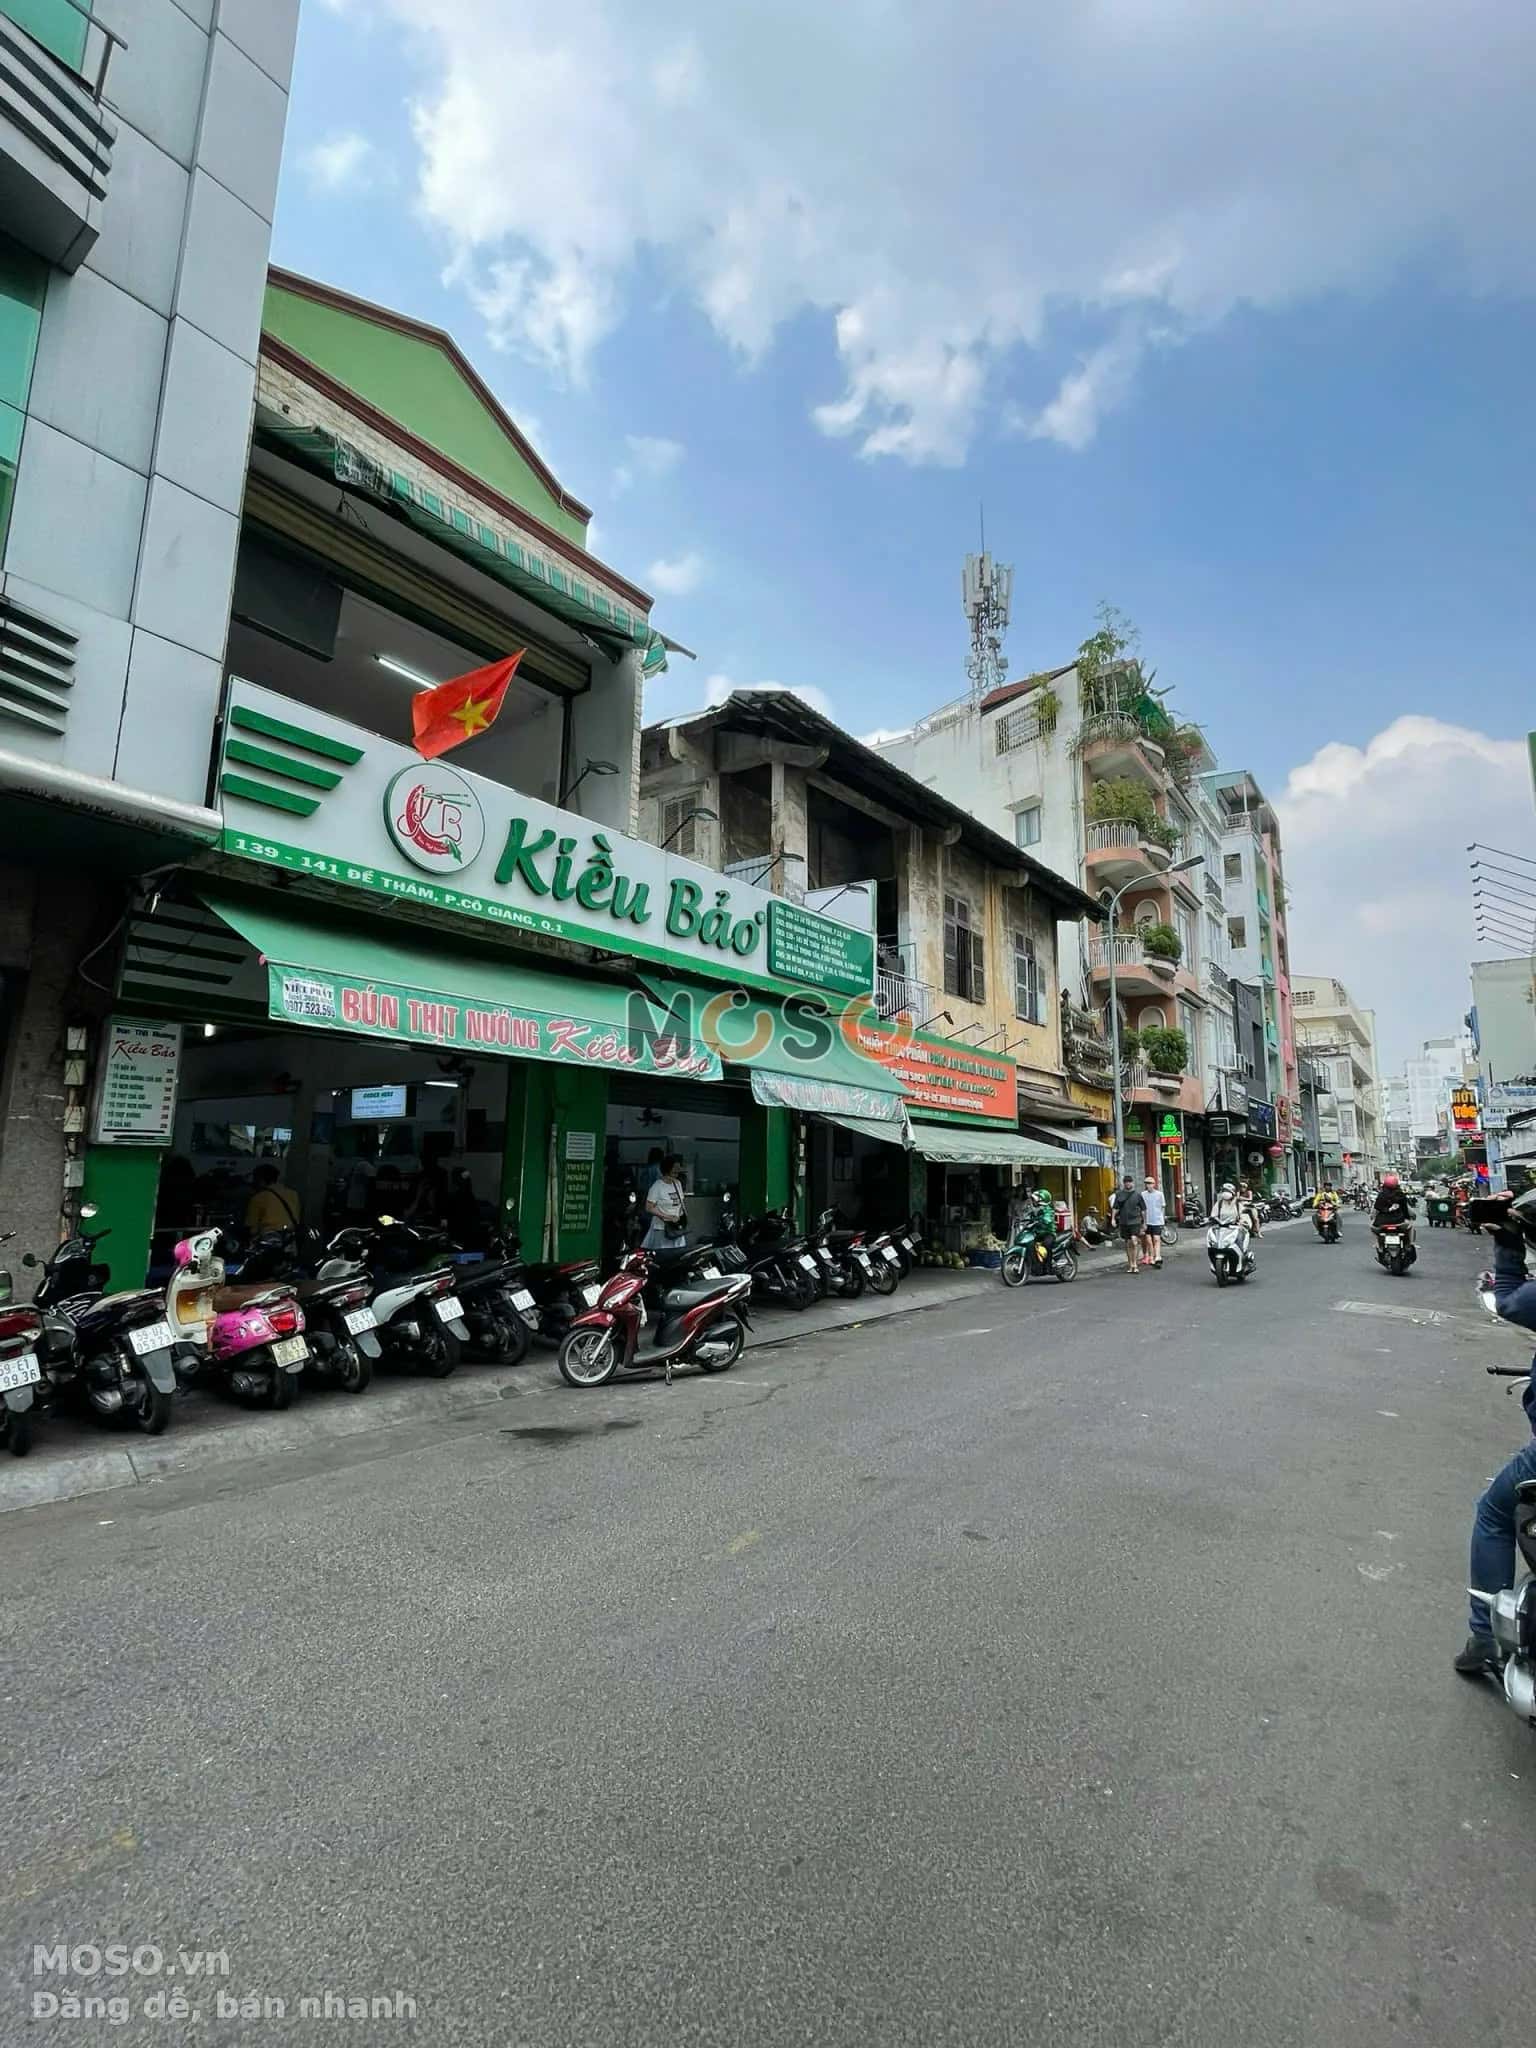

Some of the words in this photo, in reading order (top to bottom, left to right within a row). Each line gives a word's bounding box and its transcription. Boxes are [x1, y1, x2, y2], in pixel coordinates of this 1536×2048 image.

[236, 838, 279, 859] 139
[301, 856, 338, 876] 141
[487, 904, 537, 927] GIANG,
[541, 918, 564, 934] Q.1
[494, 818, 652, 924] Kiều
[666, 878, 762, 956] Bảo
[342, 984, 400, 1031] BÚN
[408, 999, 459, 1043] THỊT
[466, 1008, 540, 1050] NƯỚNG
